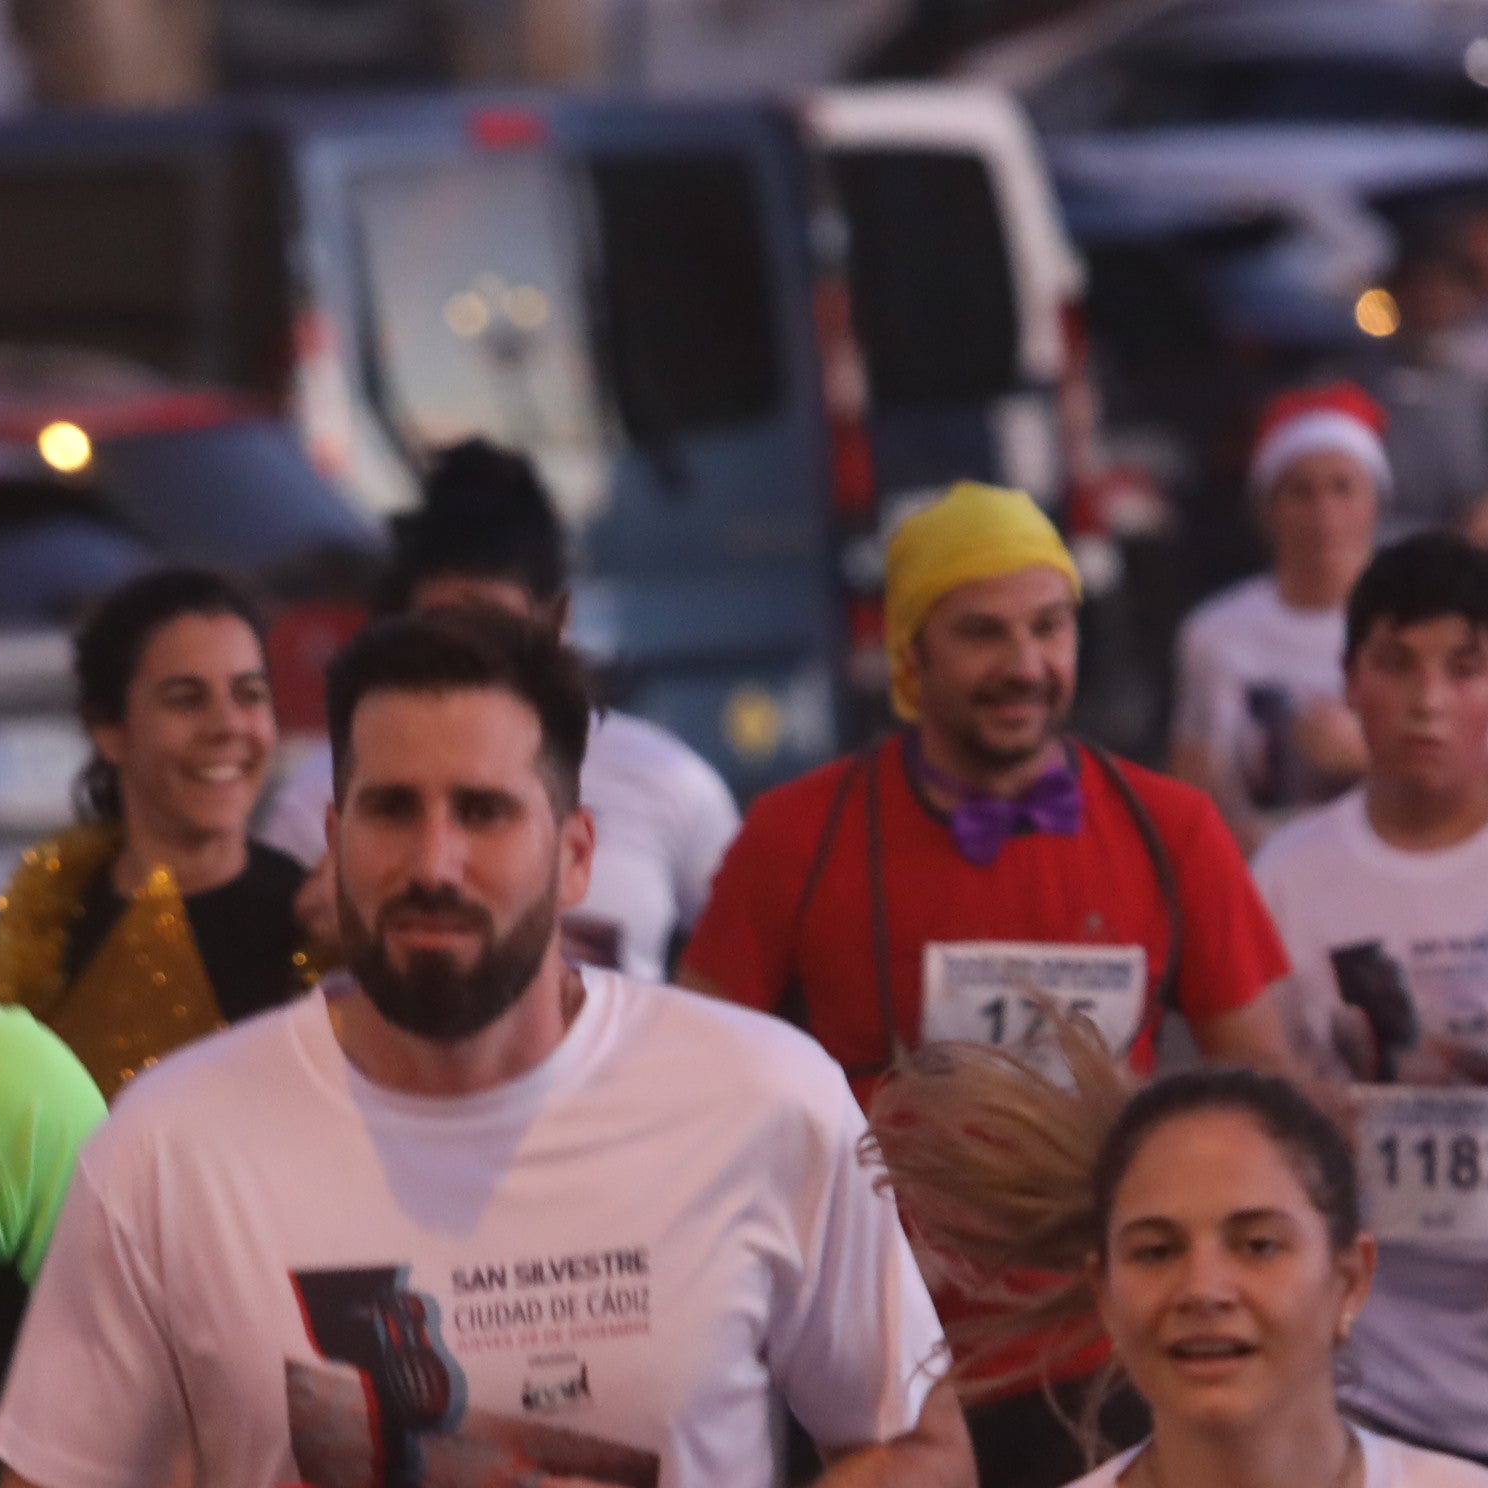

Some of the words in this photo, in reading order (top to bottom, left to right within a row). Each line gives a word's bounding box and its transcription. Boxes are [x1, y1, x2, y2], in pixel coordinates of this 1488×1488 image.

[451, 1265, 508, 1296] SAN
[514, 1247, 650, 1288] SILVESTRE
[453, 1298, 545, 1334] CIUDAD
[550, 1294, 579, 1324] DE
[585, 1284, 650, 1320] CÁDIZ
